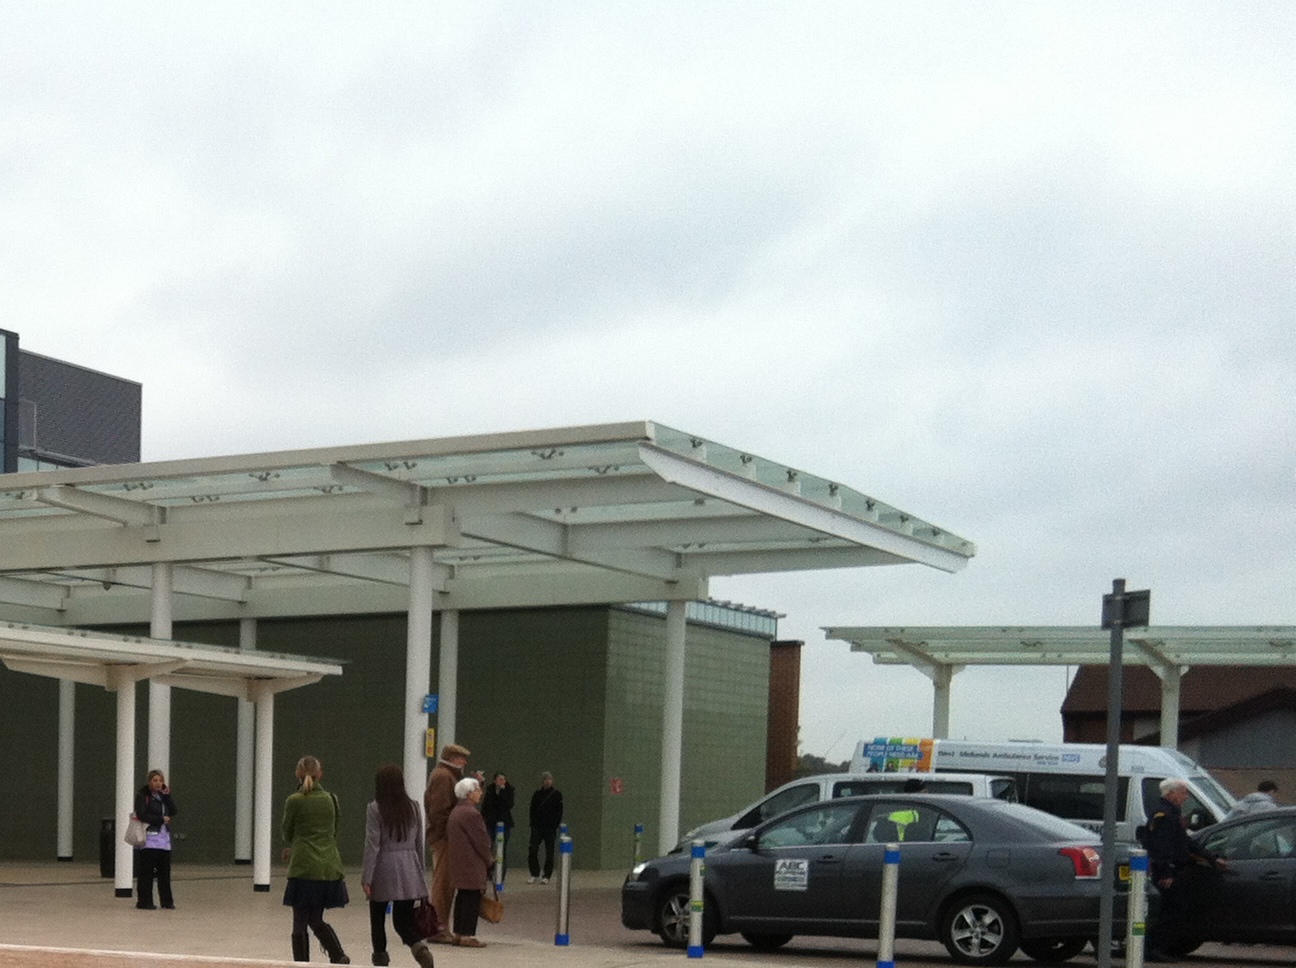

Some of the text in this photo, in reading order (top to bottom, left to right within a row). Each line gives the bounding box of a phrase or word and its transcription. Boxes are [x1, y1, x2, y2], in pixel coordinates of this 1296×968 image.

[959, 750, 990, 758] Midlands
[992, 752, 1032, 760] Ambulance
[1033, 753, 1059, 761] Service
[778, 861, 805, 870] ABC
